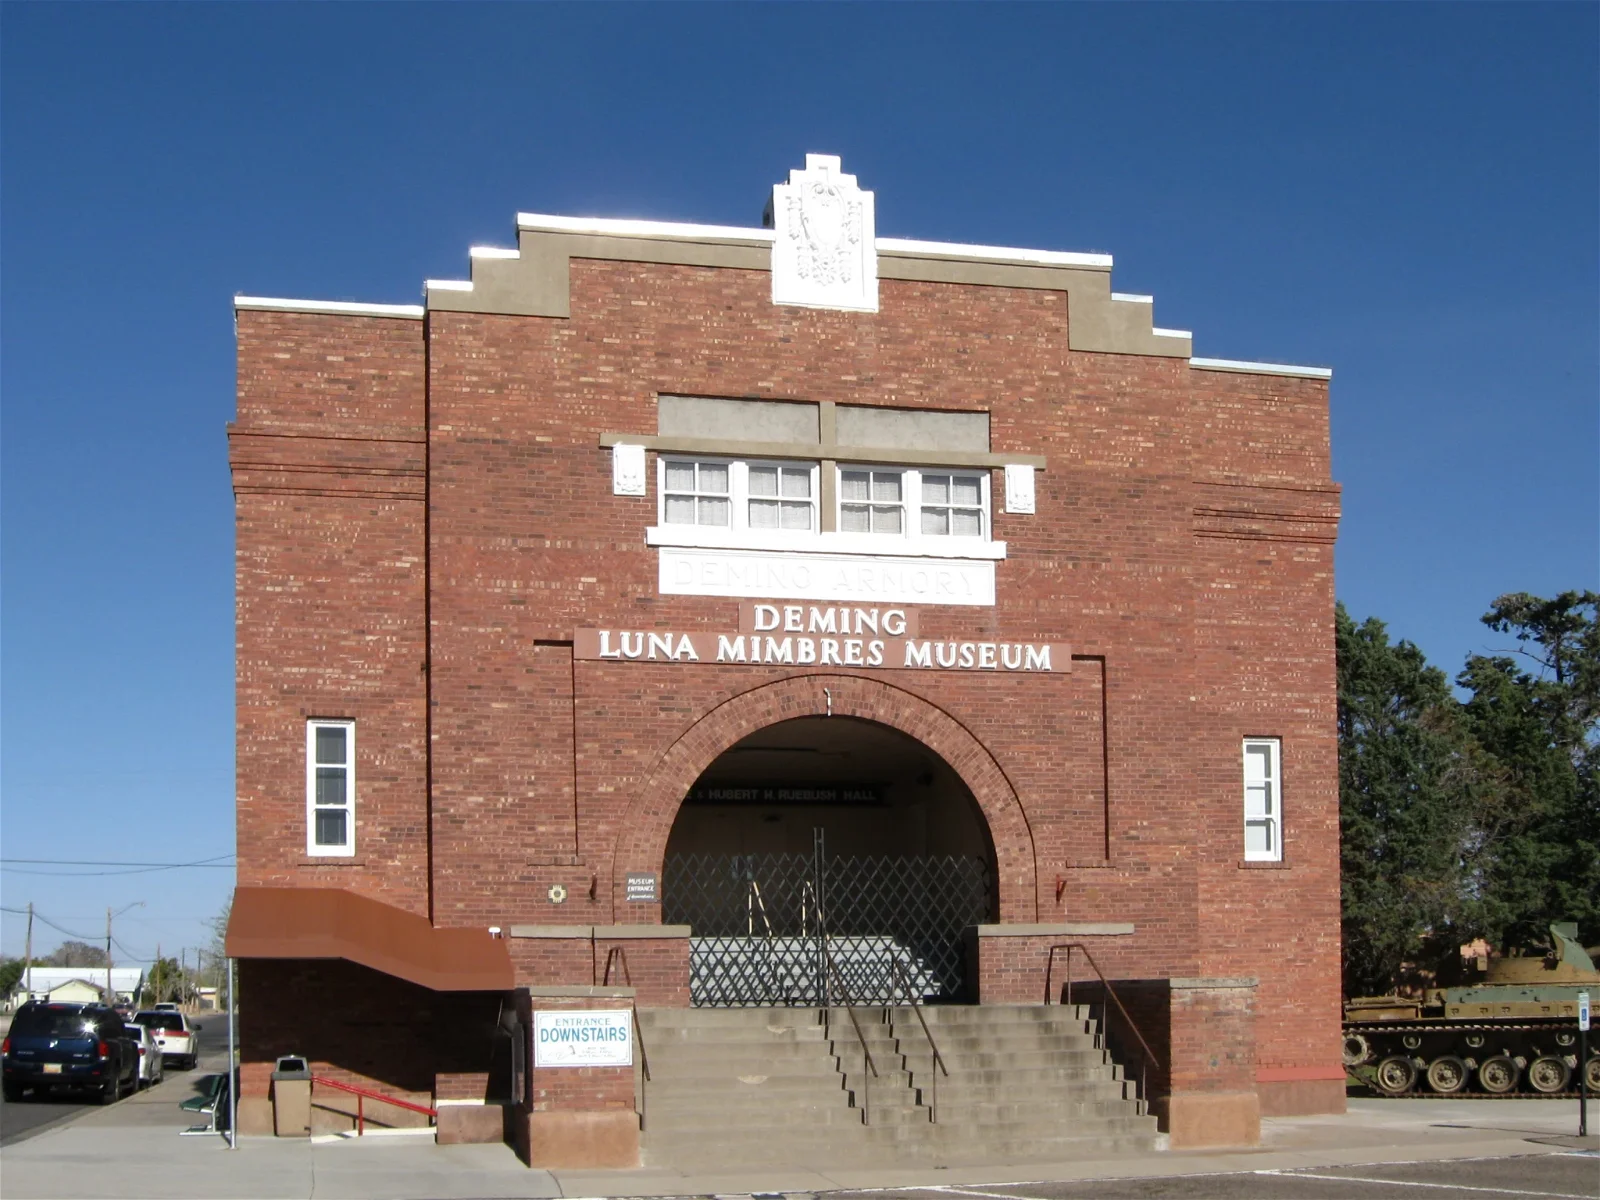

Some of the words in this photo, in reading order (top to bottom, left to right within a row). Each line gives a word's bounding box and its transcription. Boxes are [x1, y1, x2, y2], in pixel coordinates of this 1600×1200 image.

[674, 560, 812, 590] DEMING
[832, 568, 974, 596] ARMORY
[754, 604, 907, 635] DEMING
[599, 630, 698, 661] LUNA
[717, 635, 884, 666] MIMBRES
[905, 640, 1051, 671] MUSEUM
[709, 789, 759, 800] HUBERT
[843, 790, 876, 801] HALL
[555, 1018, 611, 1027] ENTRANCE
[540, 1027, 627, 1042] DOWNSTAIRS
